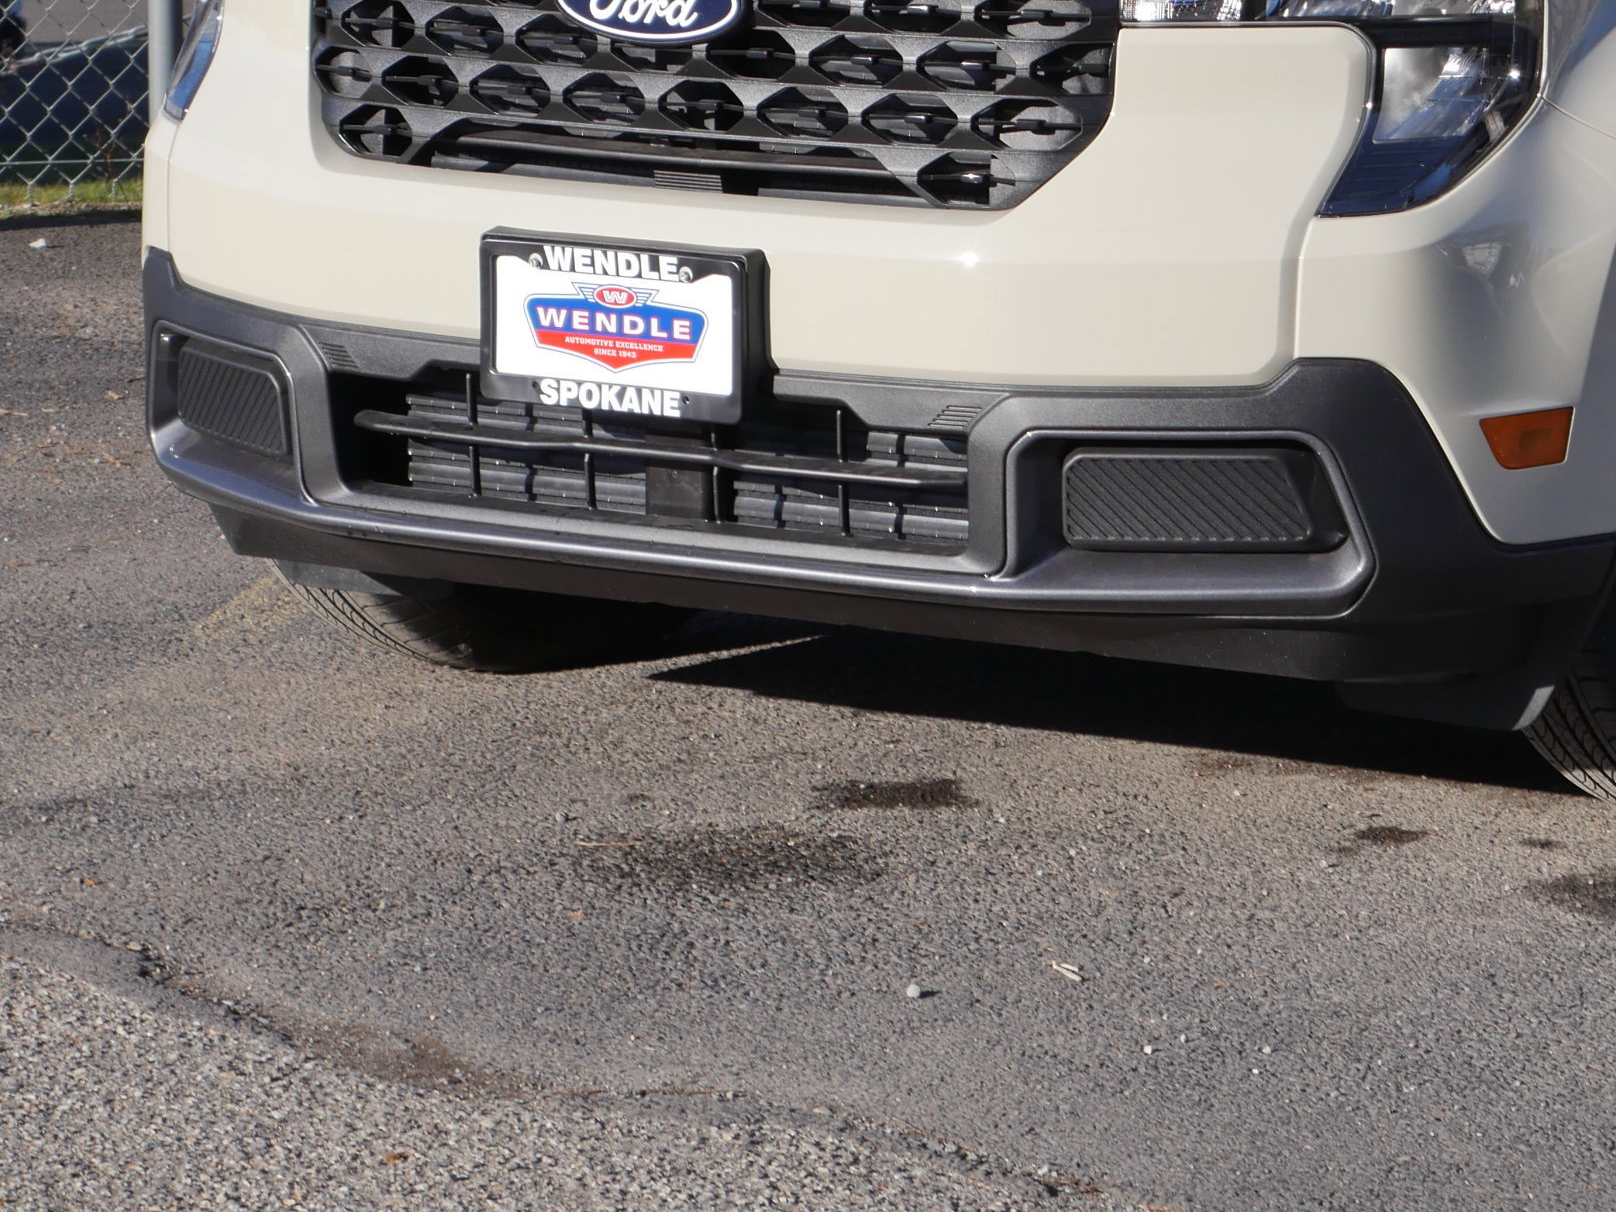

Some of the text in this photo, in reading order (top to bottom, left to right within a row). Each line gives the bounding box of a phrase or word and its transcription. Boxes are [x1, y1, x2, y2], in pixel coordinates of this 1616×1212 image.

[543, 245, 680, 281] WENDLE
[536, 306, 691, 340] WENDLE
[565, 335, 664, 352] AUTOMOTIVE EXCELLENCE
[593, 347, 637, 359] SINCE 1943
[539, 378, 681, 418] SPOKANE
